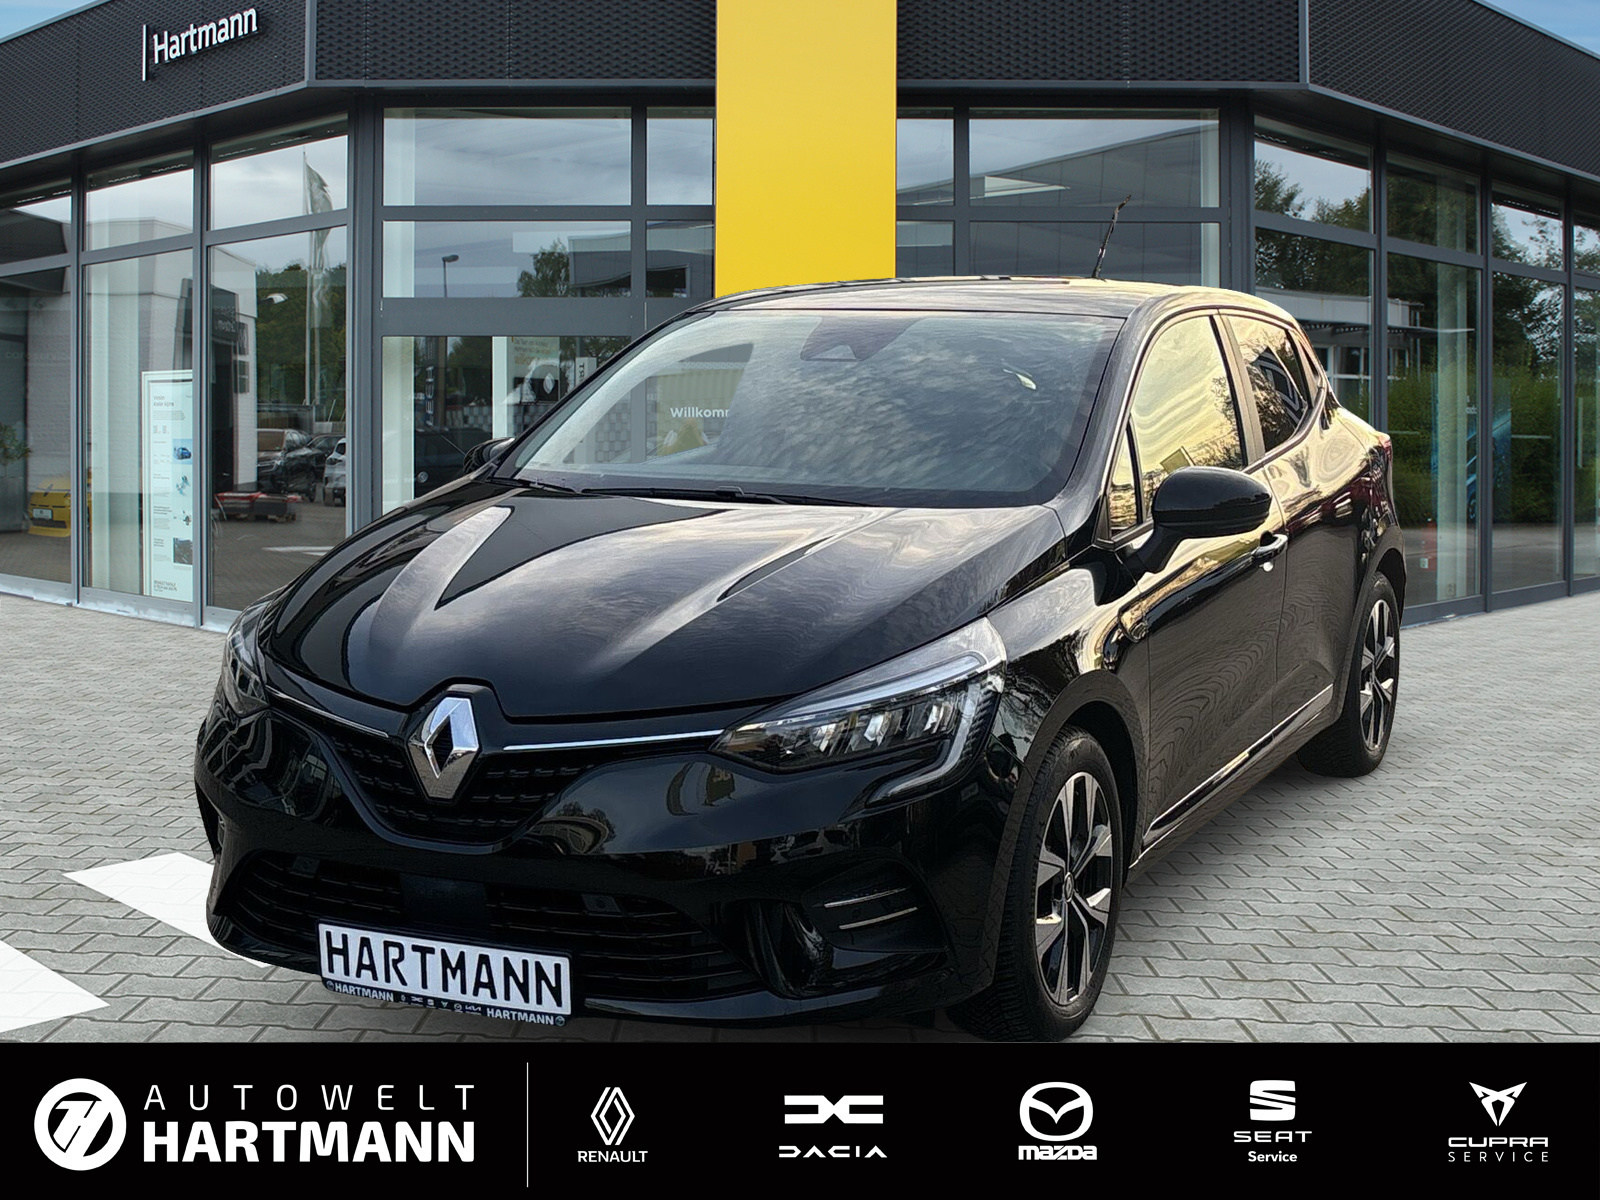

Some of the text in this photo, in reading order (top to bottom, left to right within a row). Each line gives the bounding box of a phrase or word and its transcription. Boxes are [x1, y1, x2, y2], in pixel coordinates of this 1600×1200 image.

[152, 8, 258, 64] Hartmann
[325, 930, 563, 1008] HARTMANN
[334, 983, 394, 1003] HARTMANN
[486, 1006, 555, 1026] HARTMANN
